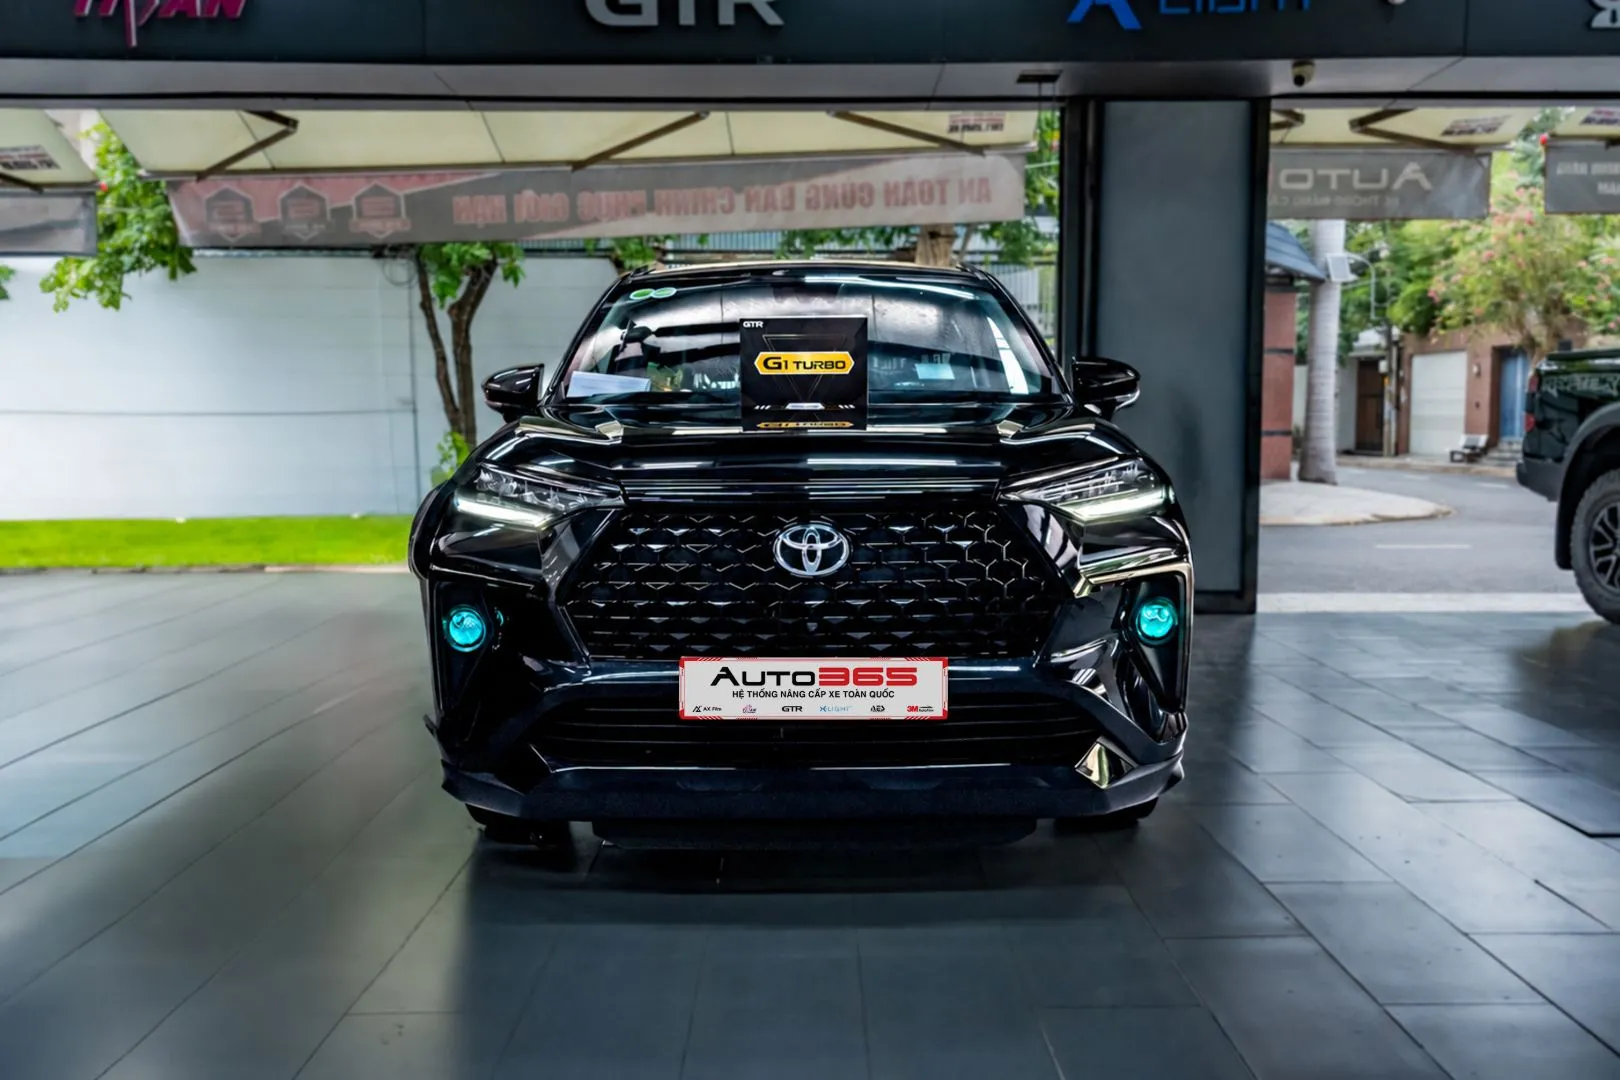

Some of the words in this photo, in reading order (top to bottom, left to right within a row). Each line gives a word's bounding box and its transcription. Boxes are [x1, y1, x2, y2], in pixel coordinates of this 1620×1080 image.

[763, 357, 788, 370] G1
[793, 360, 846, 370] TURBO
[732, 689, 744, 699] HỆ
[747, 688, 778, 698] THỐNG
[780, 689, 806, 698] NÂNG
[808, 687, 826, 698] CẤP
[829, 690, 841, 698] XE
[843, 688, 867, 698] TOÀN
[869, 688, 895, 698] QUỐC
[907, 705, 919, 713] 3M
